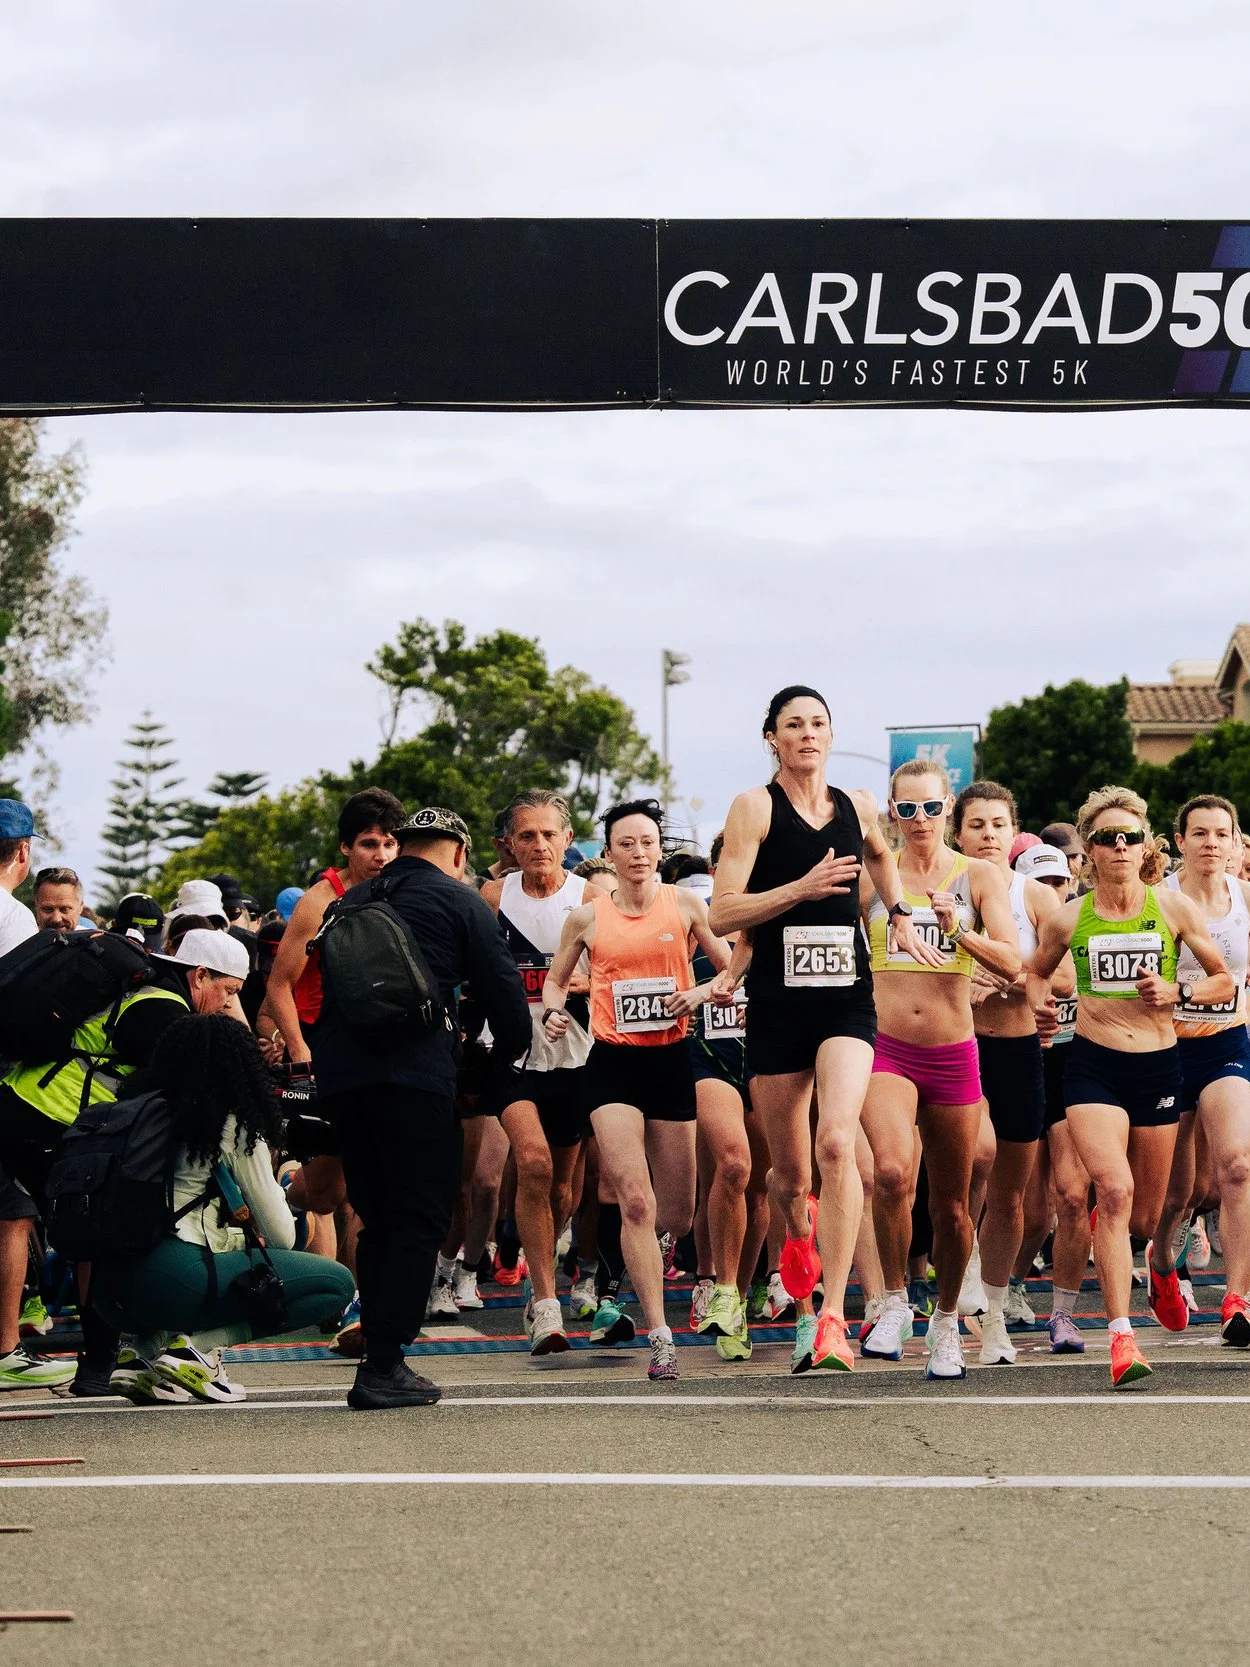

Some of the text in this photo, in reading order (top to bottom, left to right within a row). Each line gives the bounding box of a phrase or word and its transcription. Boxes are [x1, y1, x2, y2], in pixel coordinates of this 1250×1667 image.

[726, 359, 1089, 387] WORLD'S FASTEST 5K
[795, 946, 853, 973] 2653
[1099, 952, 1159, 979] 3078
[623, 995, 675, 1020] 284
[281, 1091, 310, 1100] RONIN
